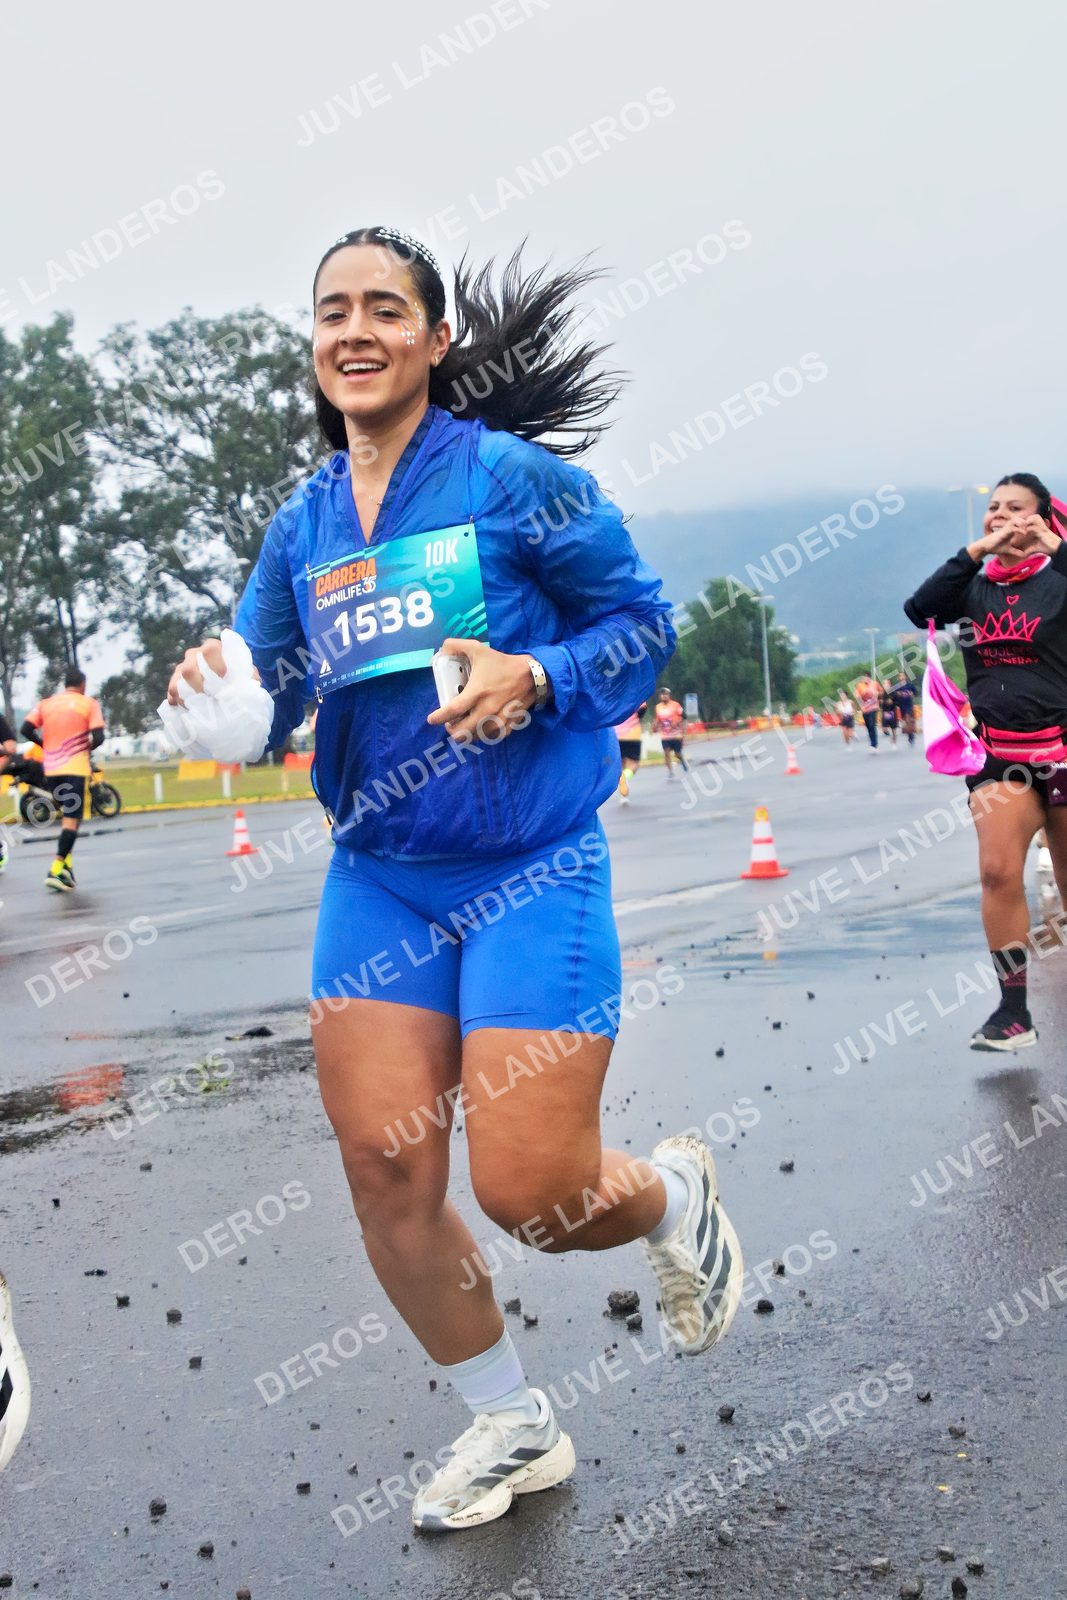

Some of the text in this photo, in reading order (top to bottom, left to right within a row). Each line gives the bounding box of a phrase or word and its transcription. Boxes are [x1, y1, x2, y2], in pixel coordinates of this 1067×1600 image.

[424, 537, 459, 568] 10K
[316, 557, 376, 597] CARRERA
[333, 590, 434, 647] 1538
